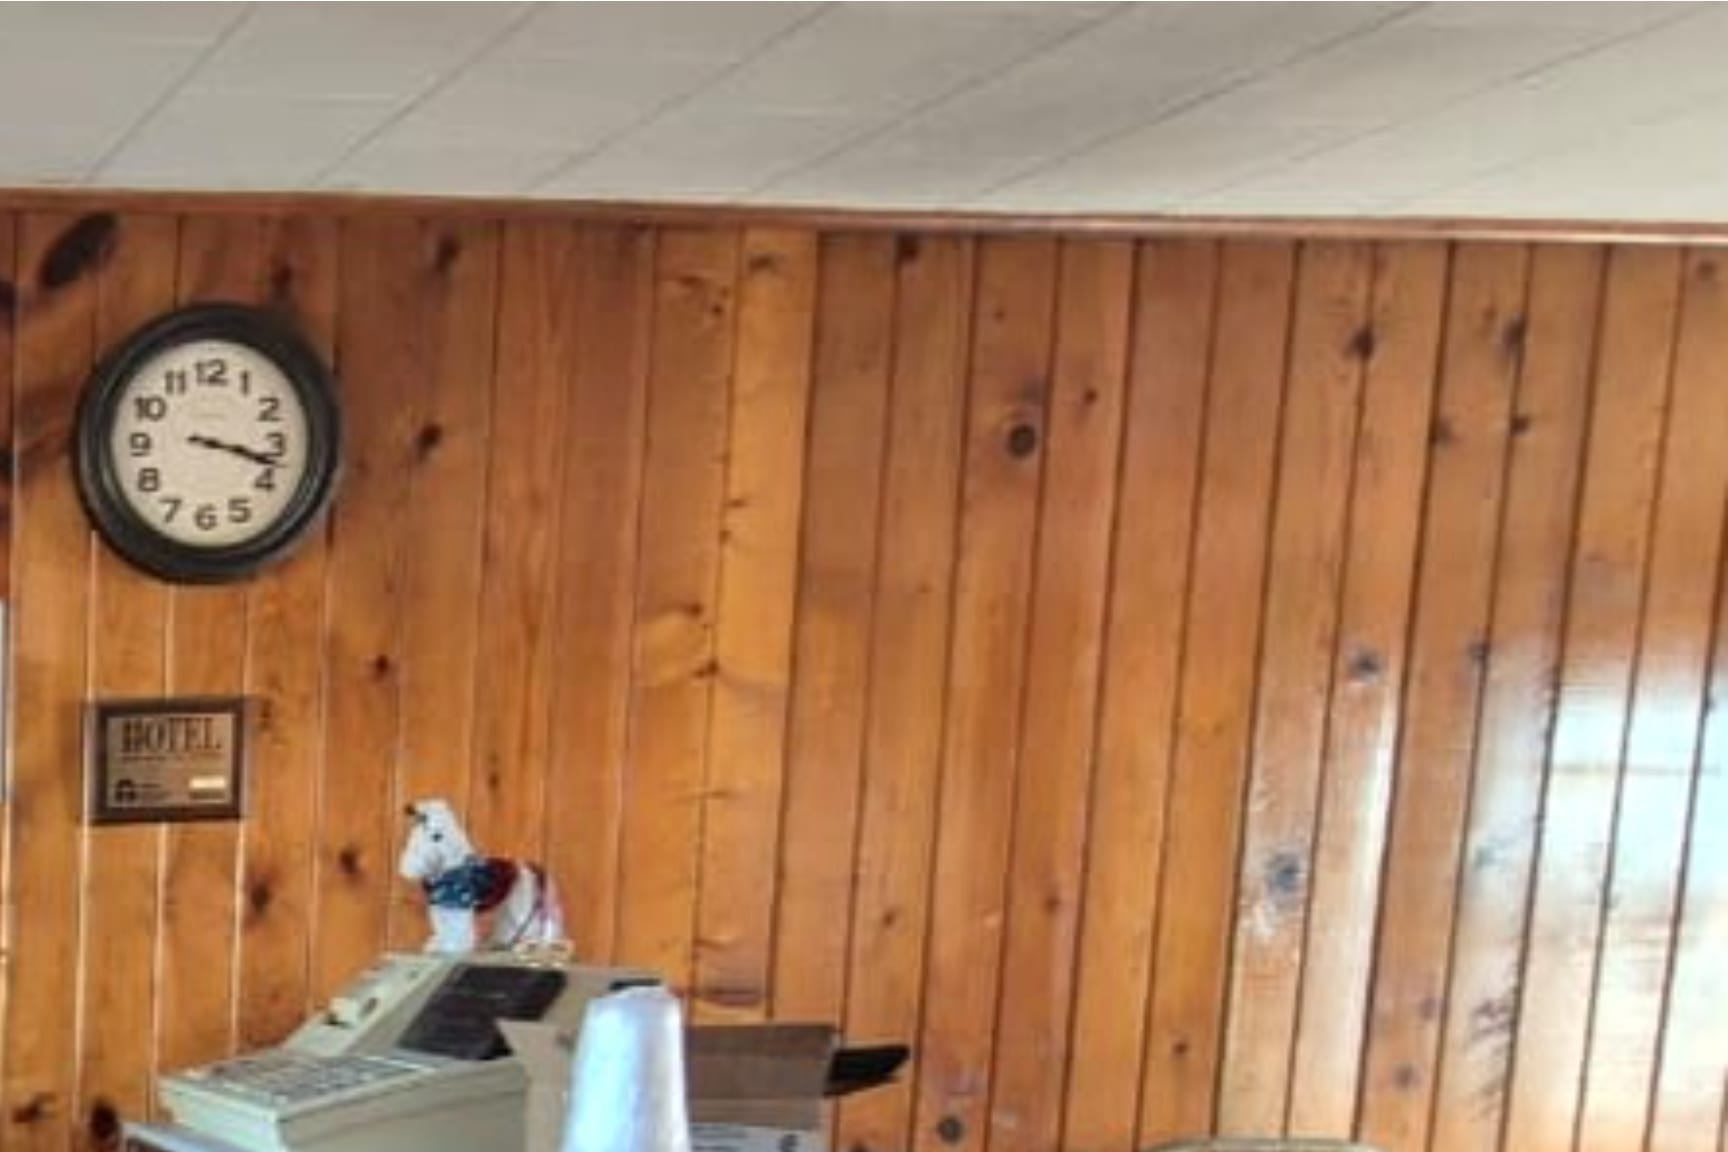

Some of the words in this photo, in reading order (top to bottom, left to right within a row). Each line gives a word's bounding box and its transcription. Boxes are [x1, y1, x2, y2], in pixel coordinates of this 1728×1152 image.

[165, 370, 186, 394] 11
[194, 358, 228, 386] 12
[239, 370, 251, 394] 1
[134, 396, 166, 421] 10
[257, 397, 282, 421] 2
[129, 432, 152, 457] 9
[265, 432, 286, 457] 3
[137, 467, 159, 492] 8
[253, 467, 274, 491] 4
[159, 499, 182, 523] 7
[194, 504, 217, 530] 6
[228, 499, 251, 523] 5
[122, 716, 222, 752] HOTEL
